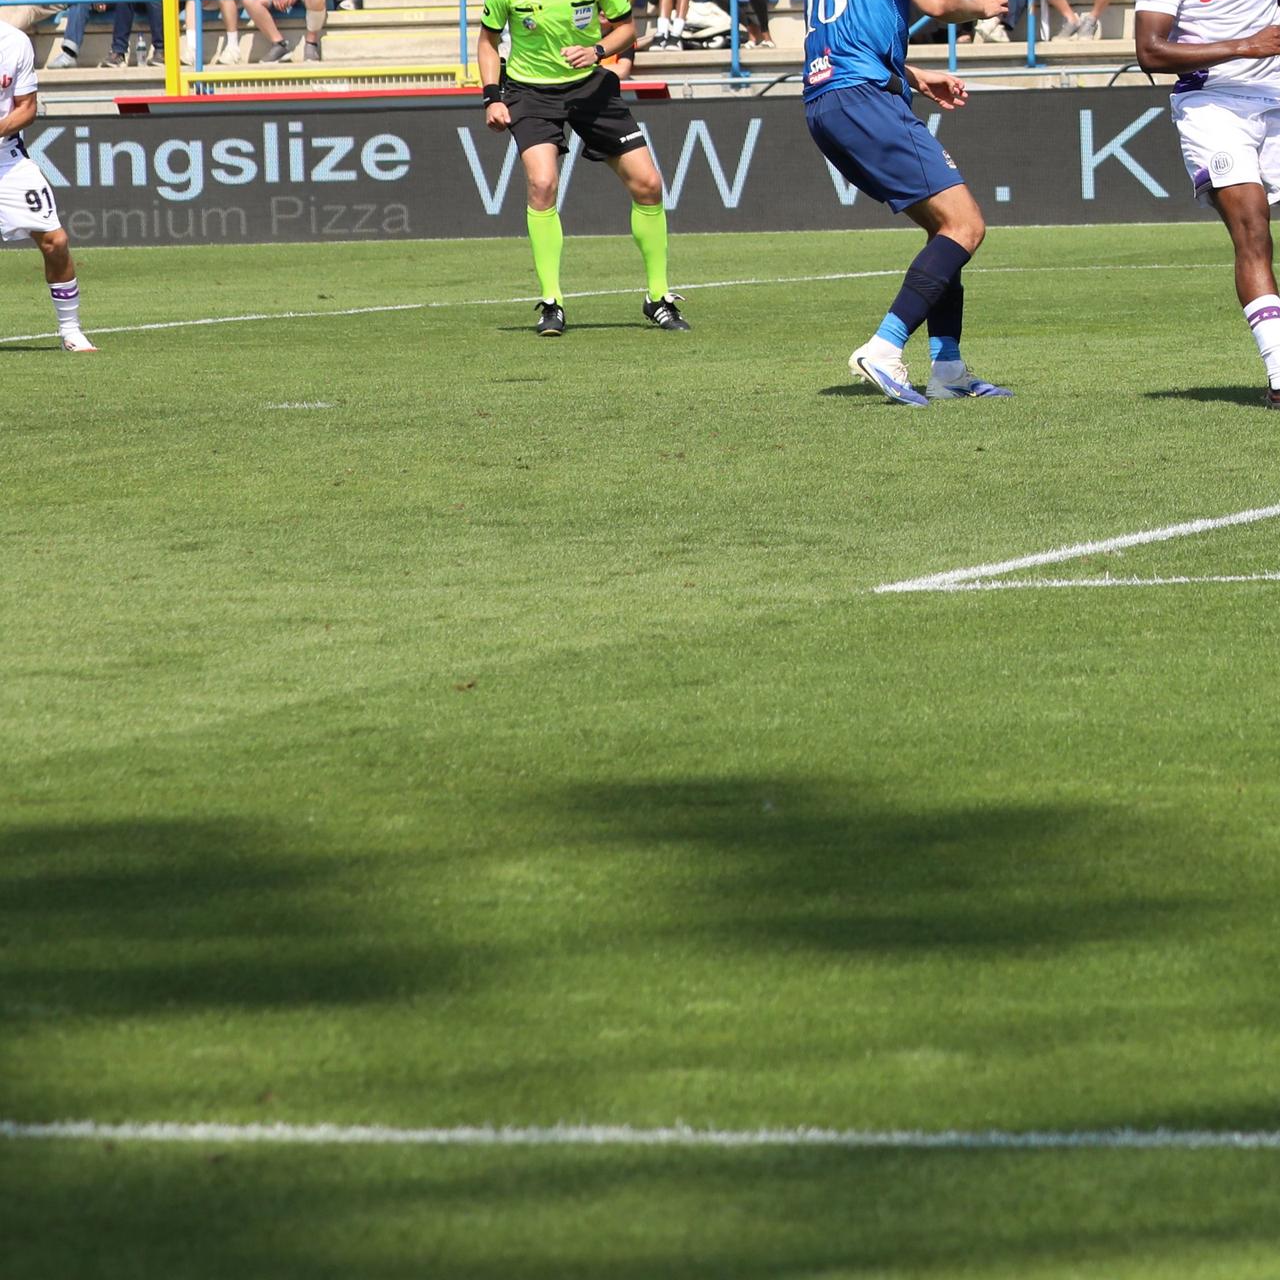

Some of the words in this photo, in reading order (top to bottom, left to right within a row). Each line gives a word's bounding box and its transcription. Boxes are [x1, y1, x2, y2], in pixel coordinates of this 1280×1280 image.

[574, 7, 593, 16] FIFA
[26, 121, 412, 202] Kingslize
[25, 185, 54, 213] 91
[270, 195, 412, 235] Pizza
